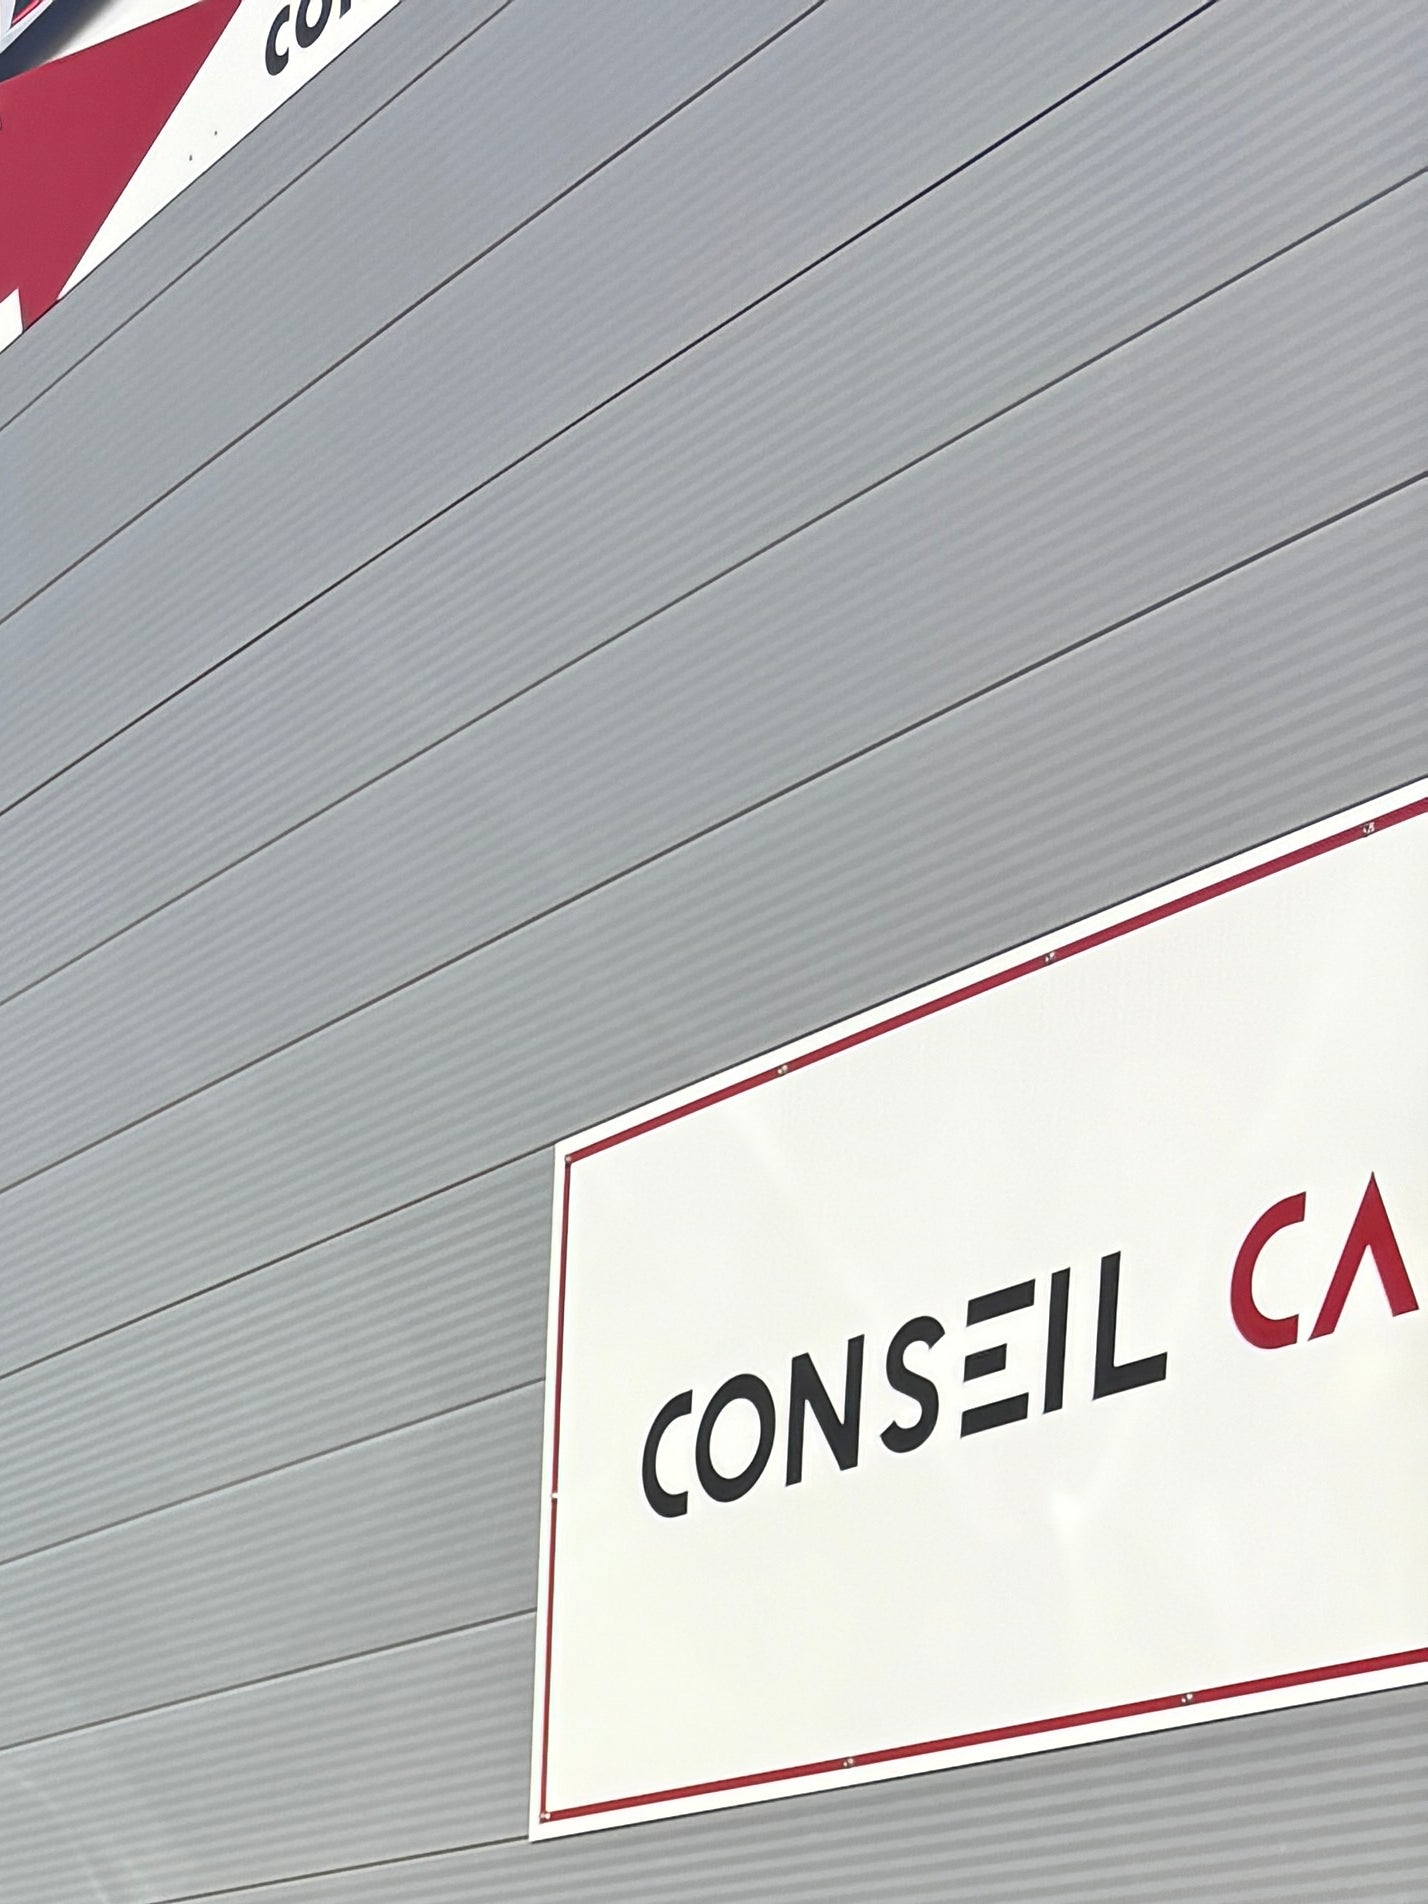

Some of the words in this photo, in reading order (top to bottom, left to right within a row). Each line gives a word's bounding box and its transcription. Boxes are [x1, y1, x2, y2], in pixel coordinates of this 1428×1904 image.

[265, 0, 352, 76] CO
[641, 1250, 1169, 1518] CONSEIL
[1229, 1170, 1420, 1350] CA
